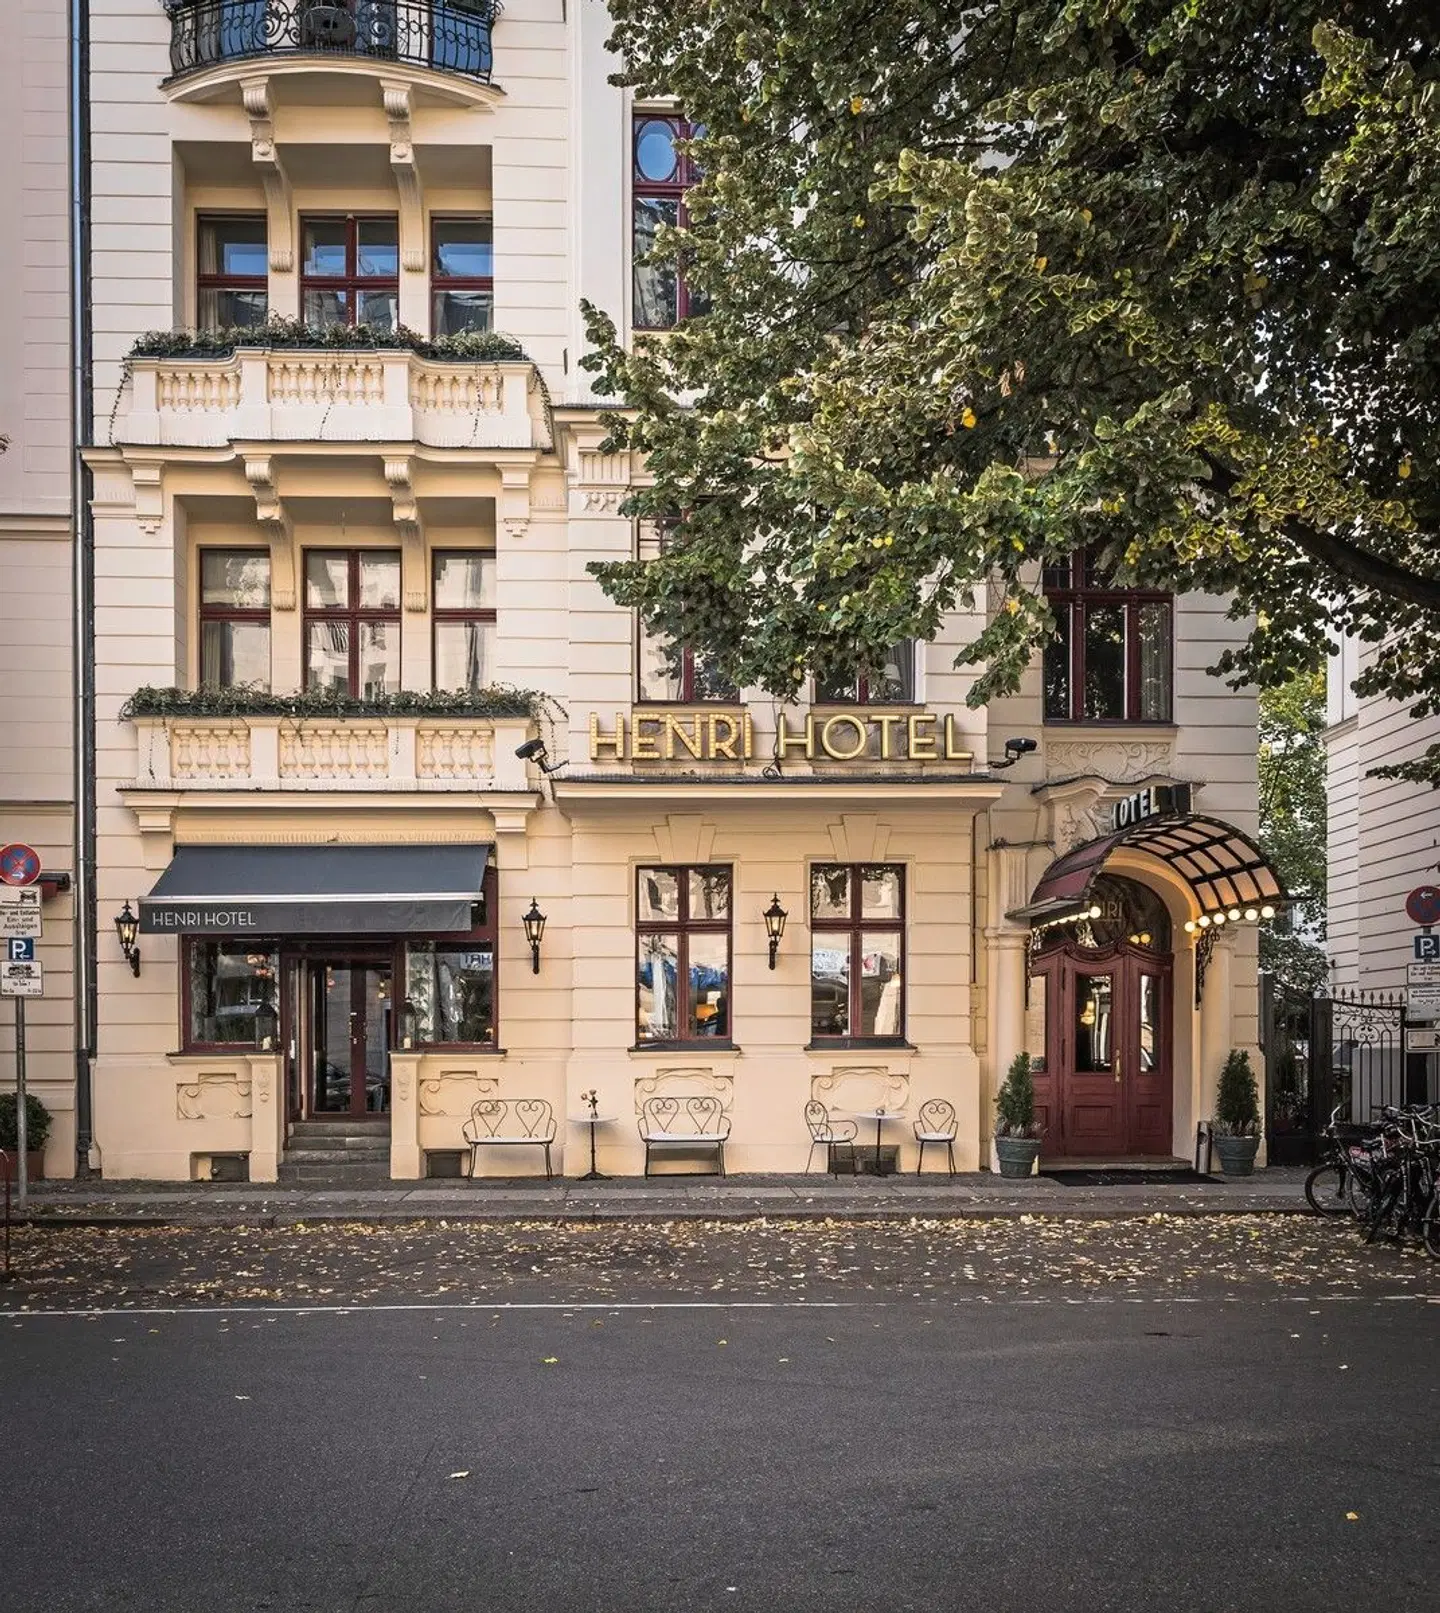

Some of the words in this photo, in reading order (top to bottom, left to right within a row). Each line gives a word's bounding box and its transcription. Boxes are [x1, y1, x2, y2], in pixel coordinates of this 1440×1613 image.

[589, 711, 752, 761] HENRI
[778, 712, 975, 761] HOTEL
[152, 911, 200, 926] HENRI
[204, 911, 257, 926] HOTEL
[12, 940, 27, 959] P
[1420, 937, 1434, 956] P
